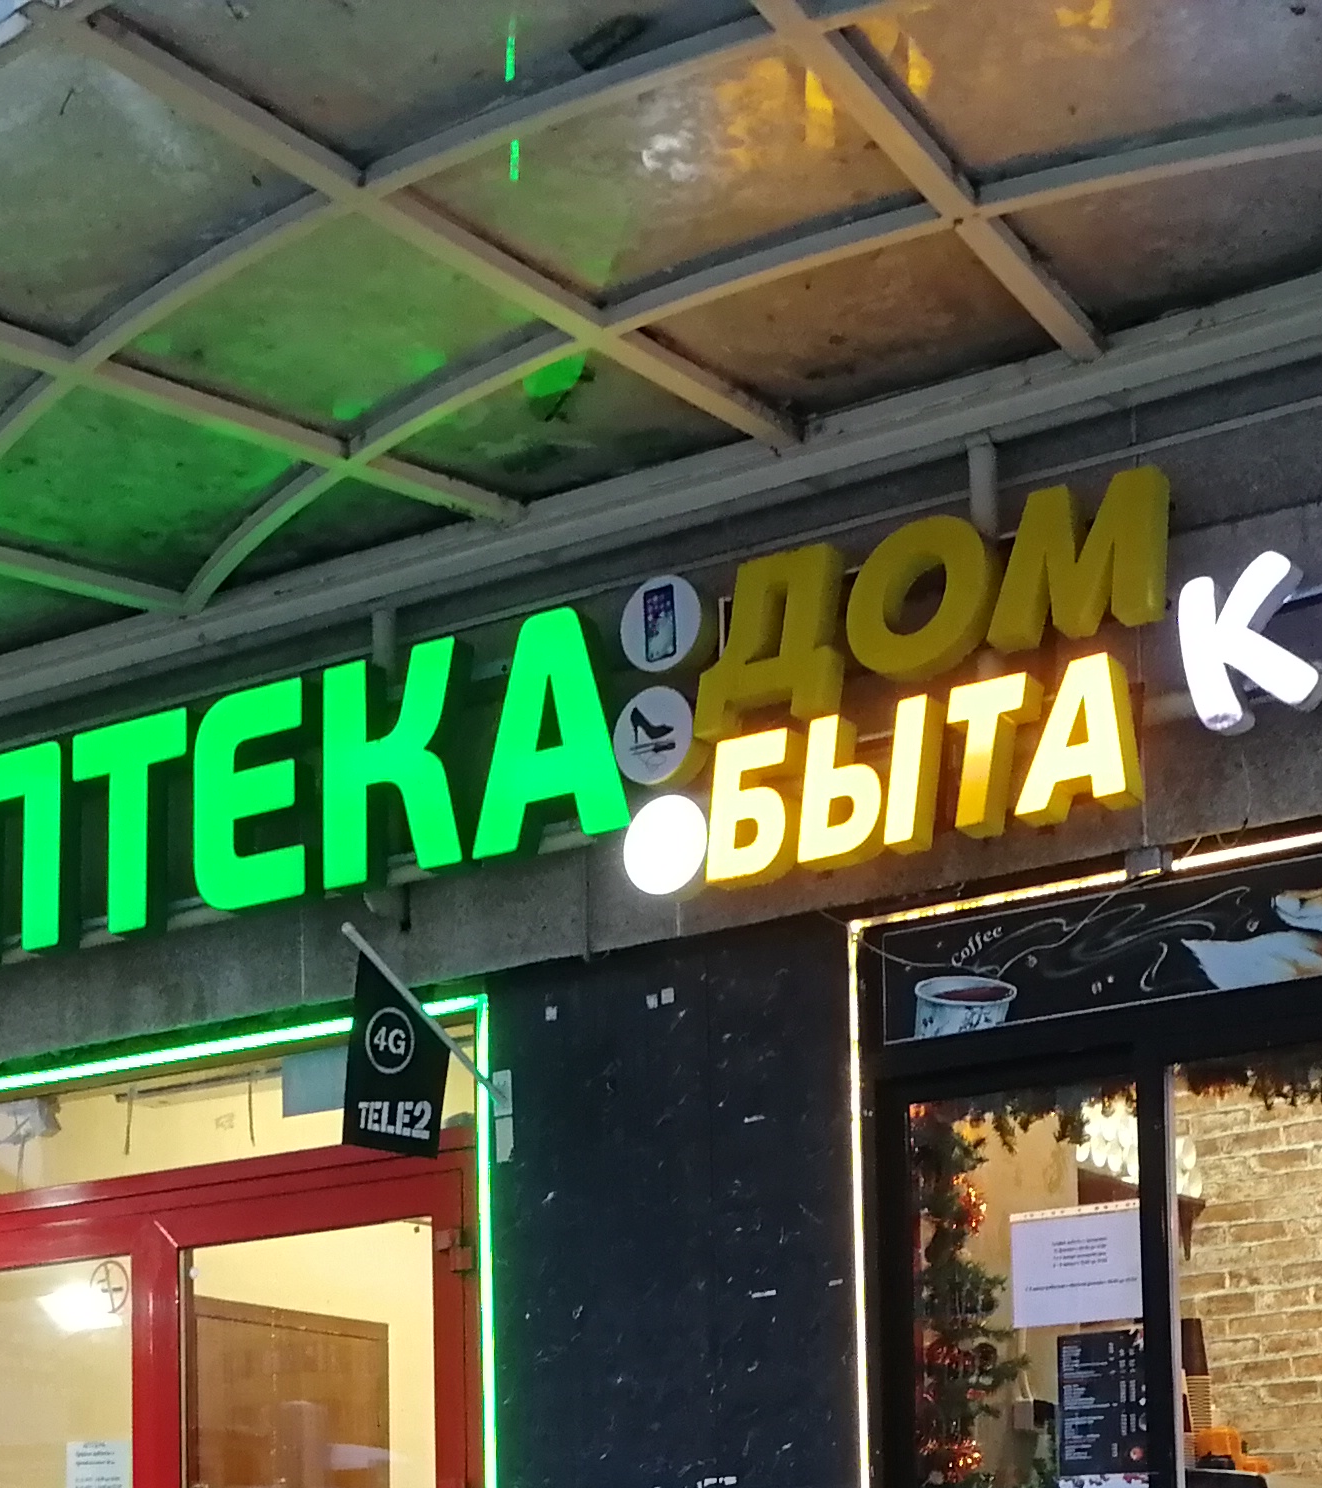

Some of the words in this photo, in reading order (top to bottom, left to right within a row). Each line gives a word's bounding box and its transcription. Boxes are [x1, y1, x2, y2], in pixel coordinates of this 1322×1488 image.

[693, 464, 1171, 742] ДОМ
[705, 652, 1143, 890] БЫТА
[951, 926, 1003, 967] coffee
[373, 1026, 407, 1056] 4G
[358, 1100, 433, 1140] TELE2
